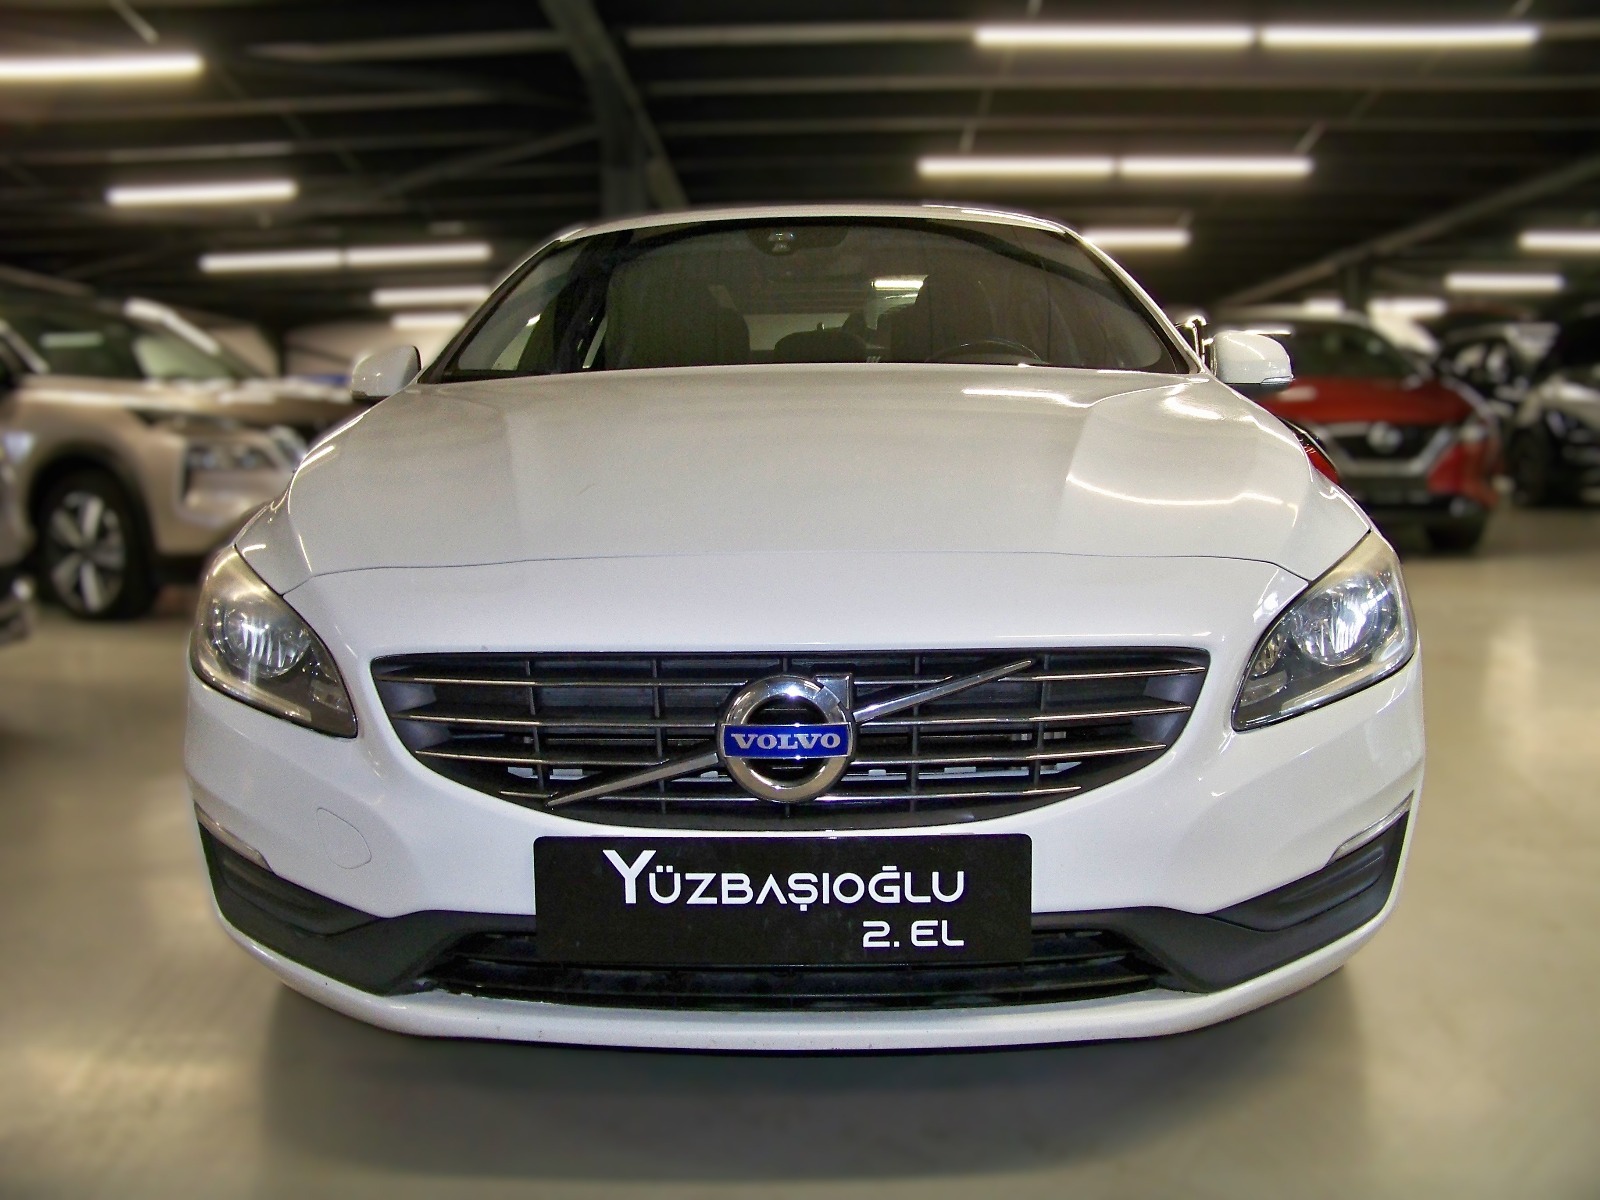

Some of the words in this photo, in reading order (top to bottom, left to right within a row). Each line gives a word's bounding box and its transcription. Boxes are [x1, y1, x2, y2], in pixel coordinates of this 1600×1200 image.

[731, 732, 841, 750] VOLVO
[603, 850, 965, 912] YÜZBAŞIOĞLU
[862, 920, 900, 947] 2.
[910, 919, 965, 947] EL
